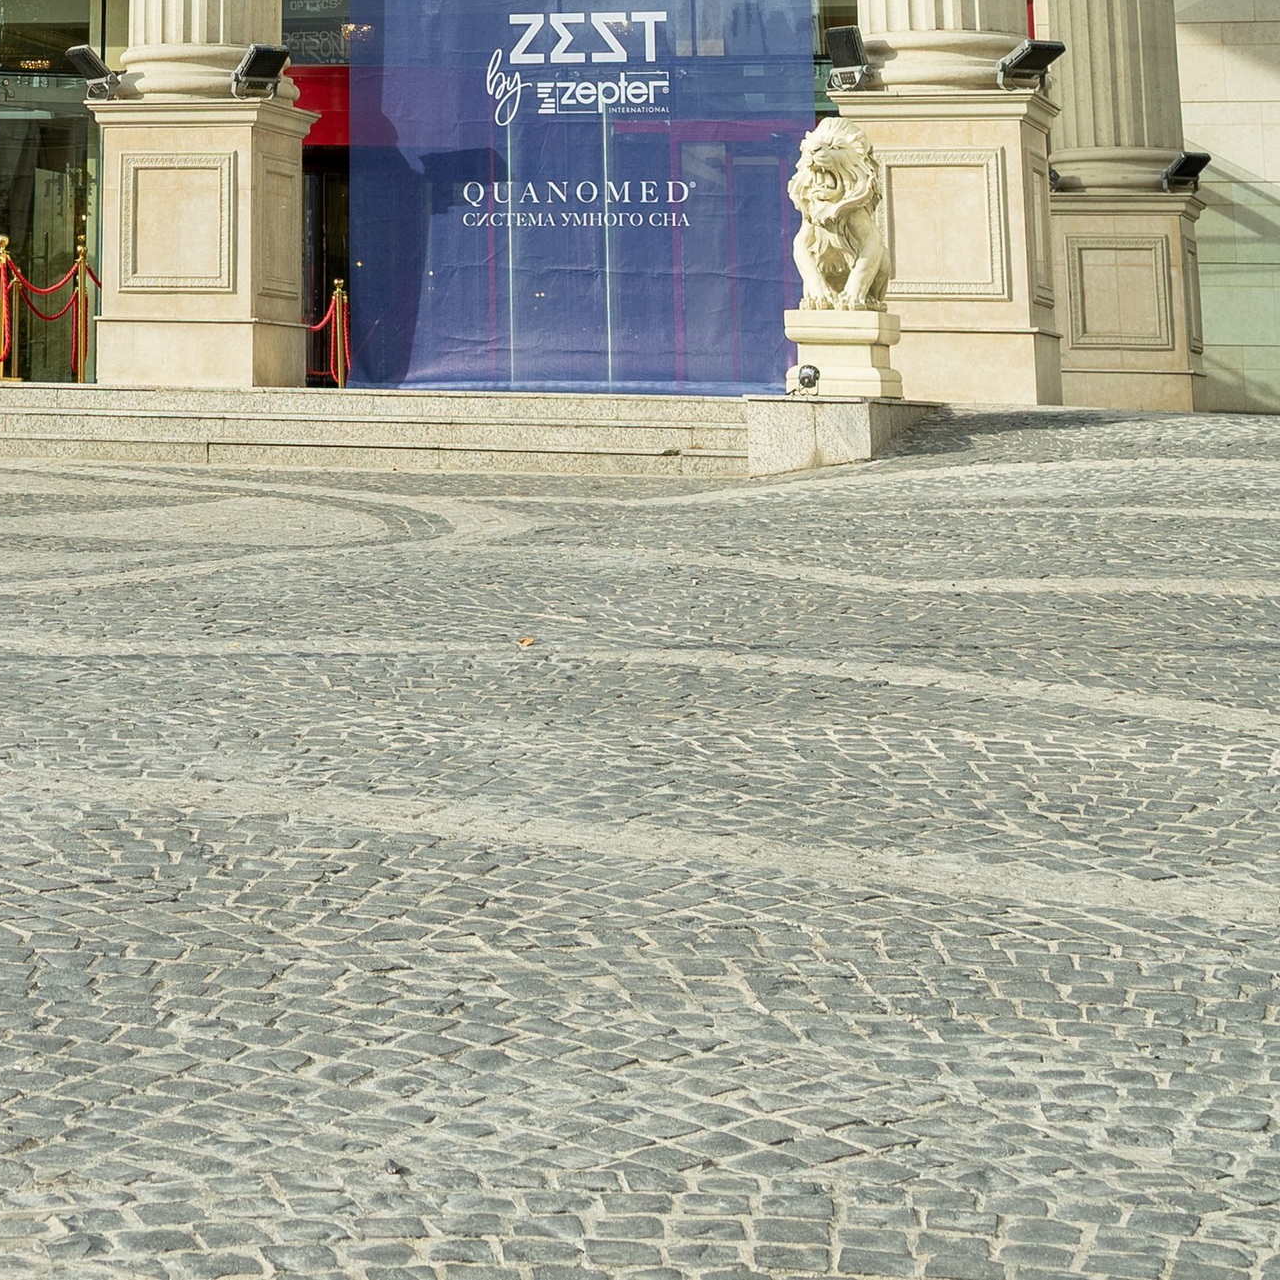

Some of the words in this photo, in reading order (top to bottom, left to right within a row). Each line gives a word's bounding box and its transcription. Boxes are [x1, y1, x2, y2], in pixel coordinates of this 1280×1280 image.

[486, 49, 533, 126] by
[556, 71, 670, 114] zepter
[608, 106, 670, 114] INTERNATIONAL
[462, 181, 690, 207] QUANOMED
[462, 212, 556, 227] СИСТЕМА
[561, 212, 644, 227] УМНОГО
[648, 212, 691, 227] СНА
